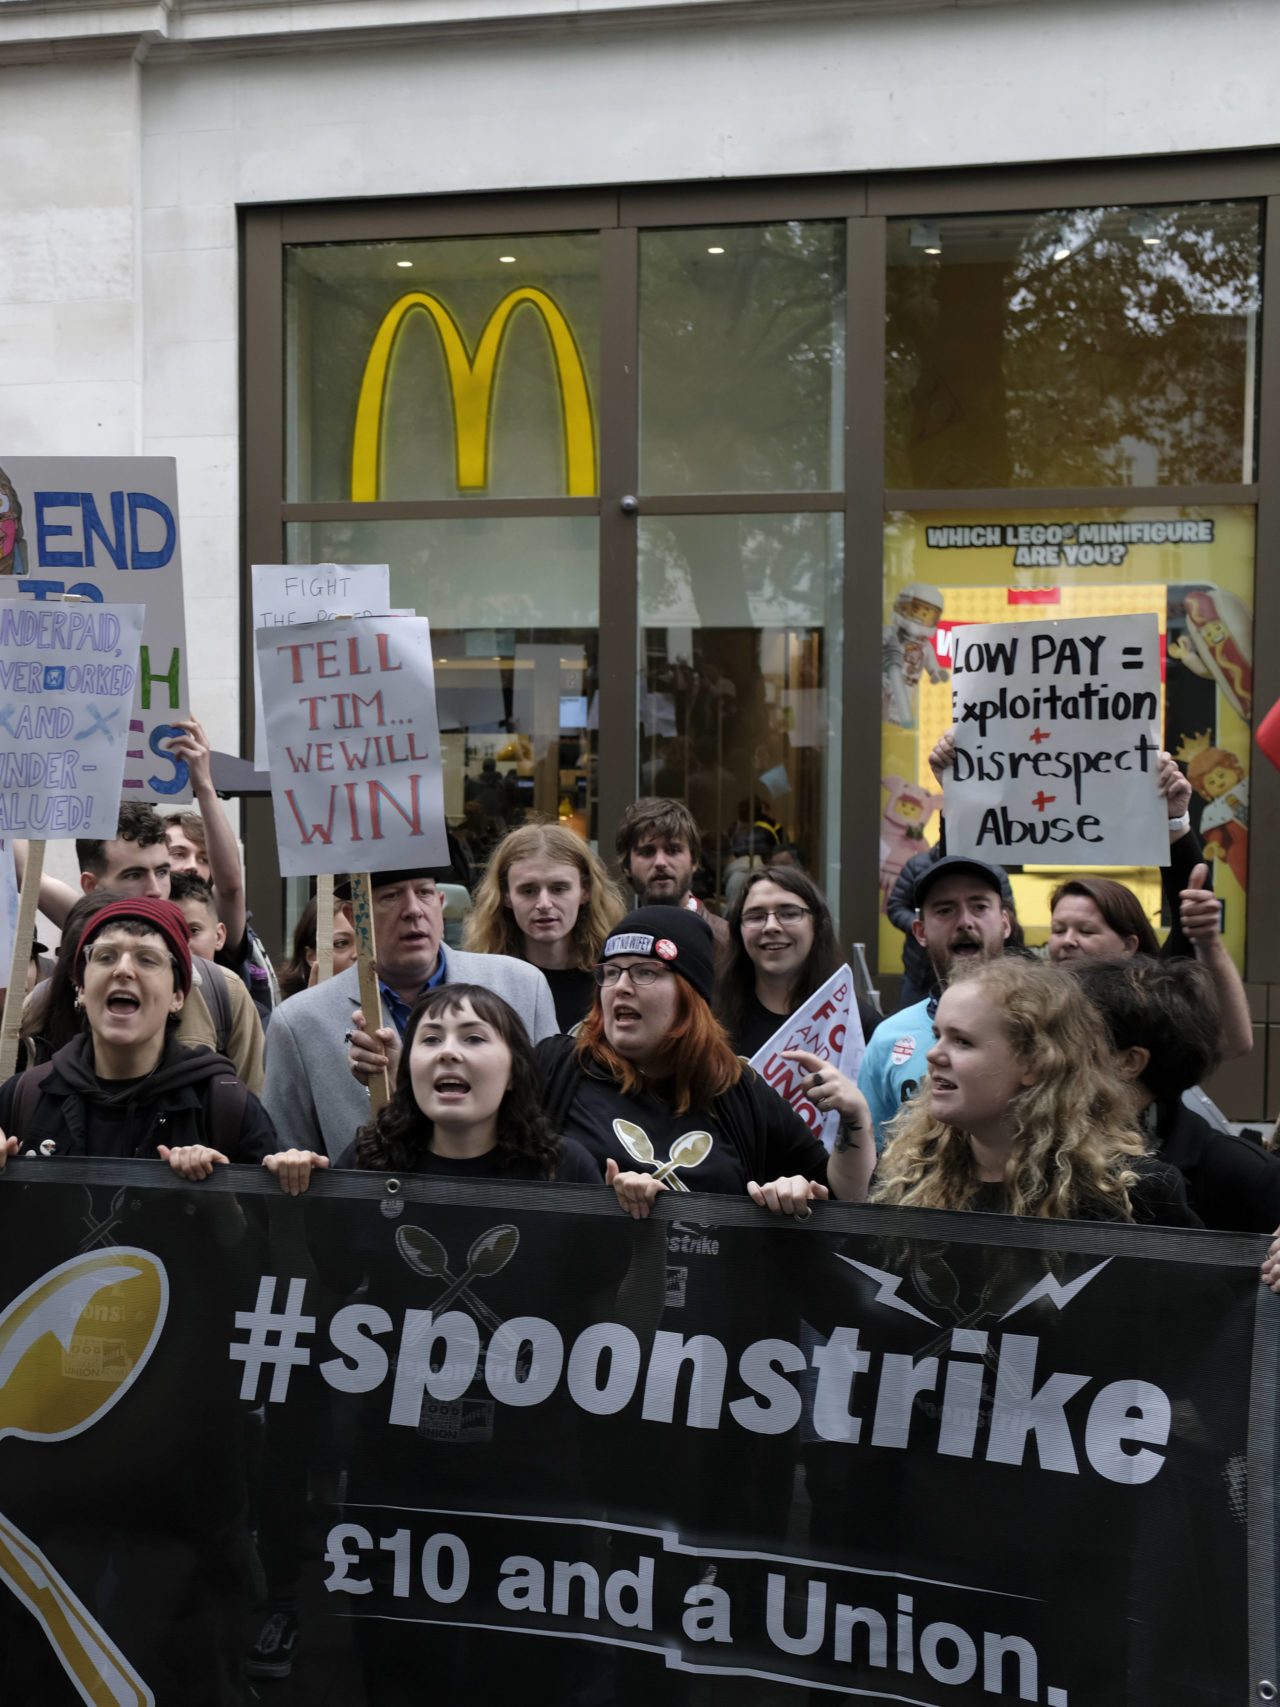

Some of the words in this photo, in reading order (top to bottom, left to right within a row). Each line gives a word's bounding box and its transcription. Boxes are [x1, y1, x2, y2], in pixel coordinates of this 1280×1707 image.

[34, 491, 176, 570] END
[927, 526, 1003, 548] WHICH
[1078, 520, 1214, 544] MINIFIGURE
[1014, 545, 1061, 567] ARE
[1063, 544, 1128, 566] YOU?
[285, 577, 351, 598] FIGHT
[260, 611, 297, 629] THE
[277, 633, 402, 684] TELL
[952, 637, 1018, 676] LOW
[1031, 634, 1107, 675] PAY
[14, 705, 74, 740] AND
[299, 689, 414, 731] TIM...
[286, 743, 334, 773] WE
[340, 733, 429, 771] WILL
[953, 734, 1161, 805] Disrespect
[284, 774, 424, 844] WIN
[975, 806, 1104, 846] Abuse
[228, 1274, 1172, 1485] #spoonstrike
[323, 1523, 470, 1604] £10
[497, 1555, 655, 1631] and
[681, 1580, 733, 1644] a
[765, 1573, 1069, 1707] Union.
